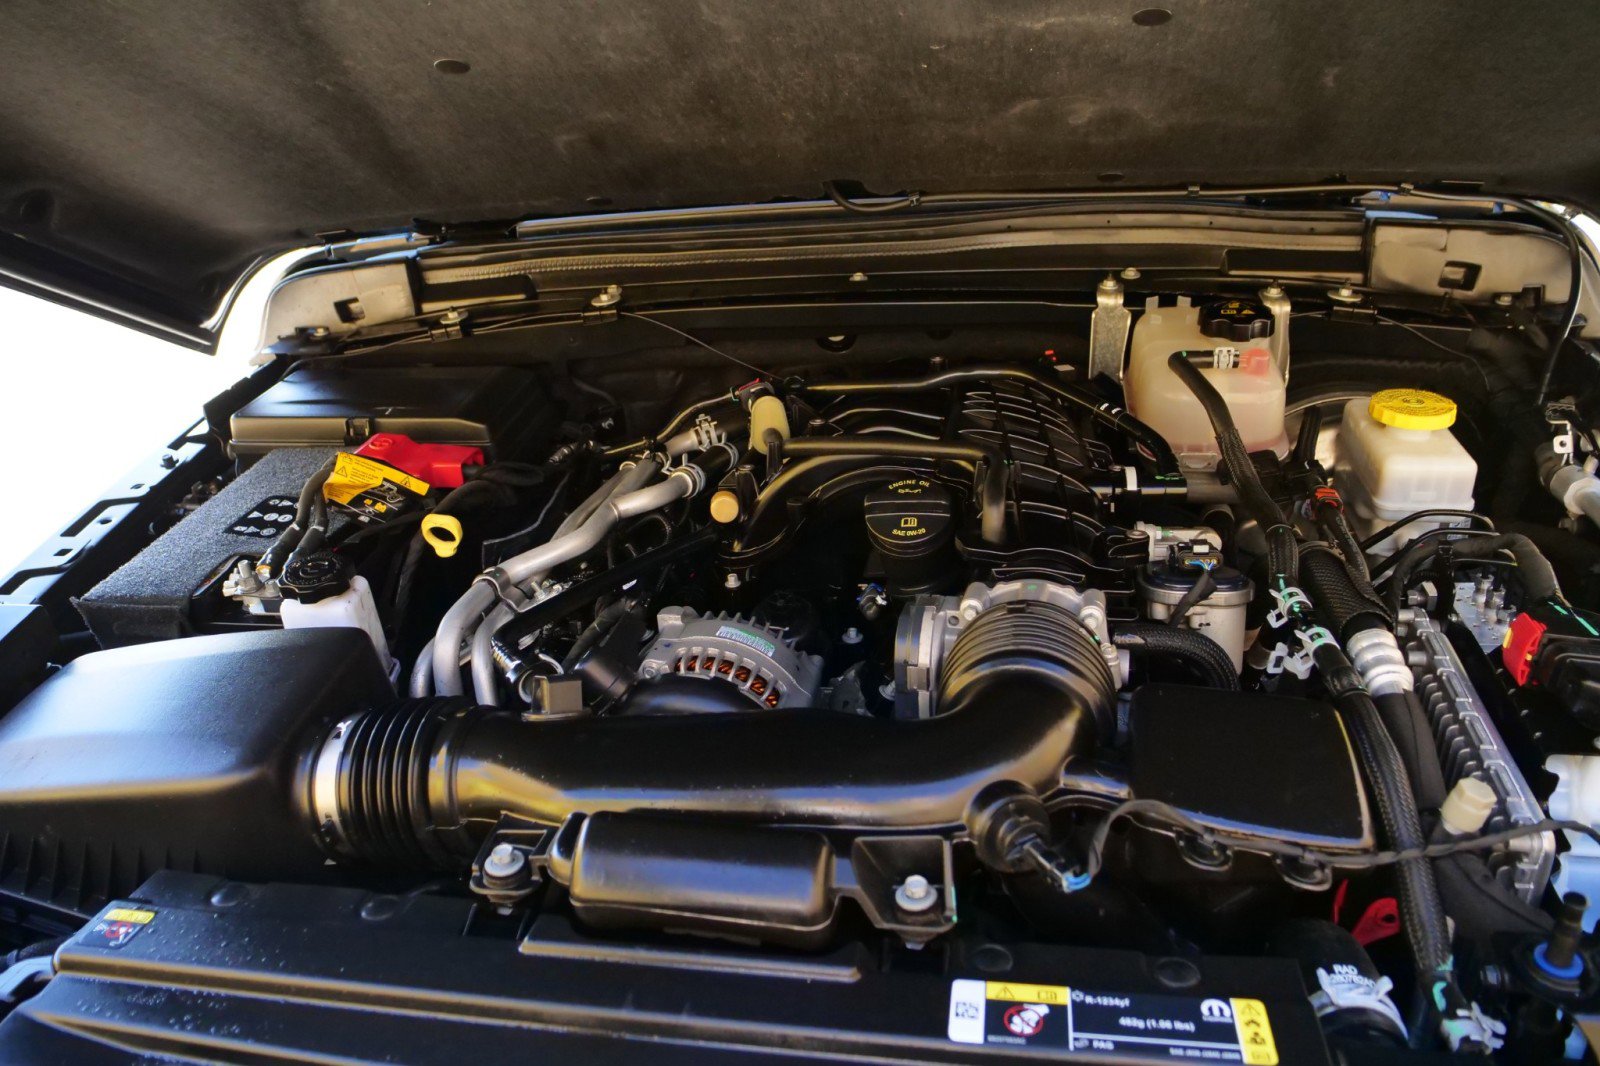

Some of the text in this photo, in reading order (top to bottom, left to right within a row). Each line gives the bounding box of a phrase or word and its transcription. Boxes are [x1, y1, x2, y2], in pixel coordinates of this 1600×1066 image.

[888, 480, 930, 490] ENGINE OIL
[892, 528, 906, 536] SAE
[1333, 963, 1358, 975] RAD
